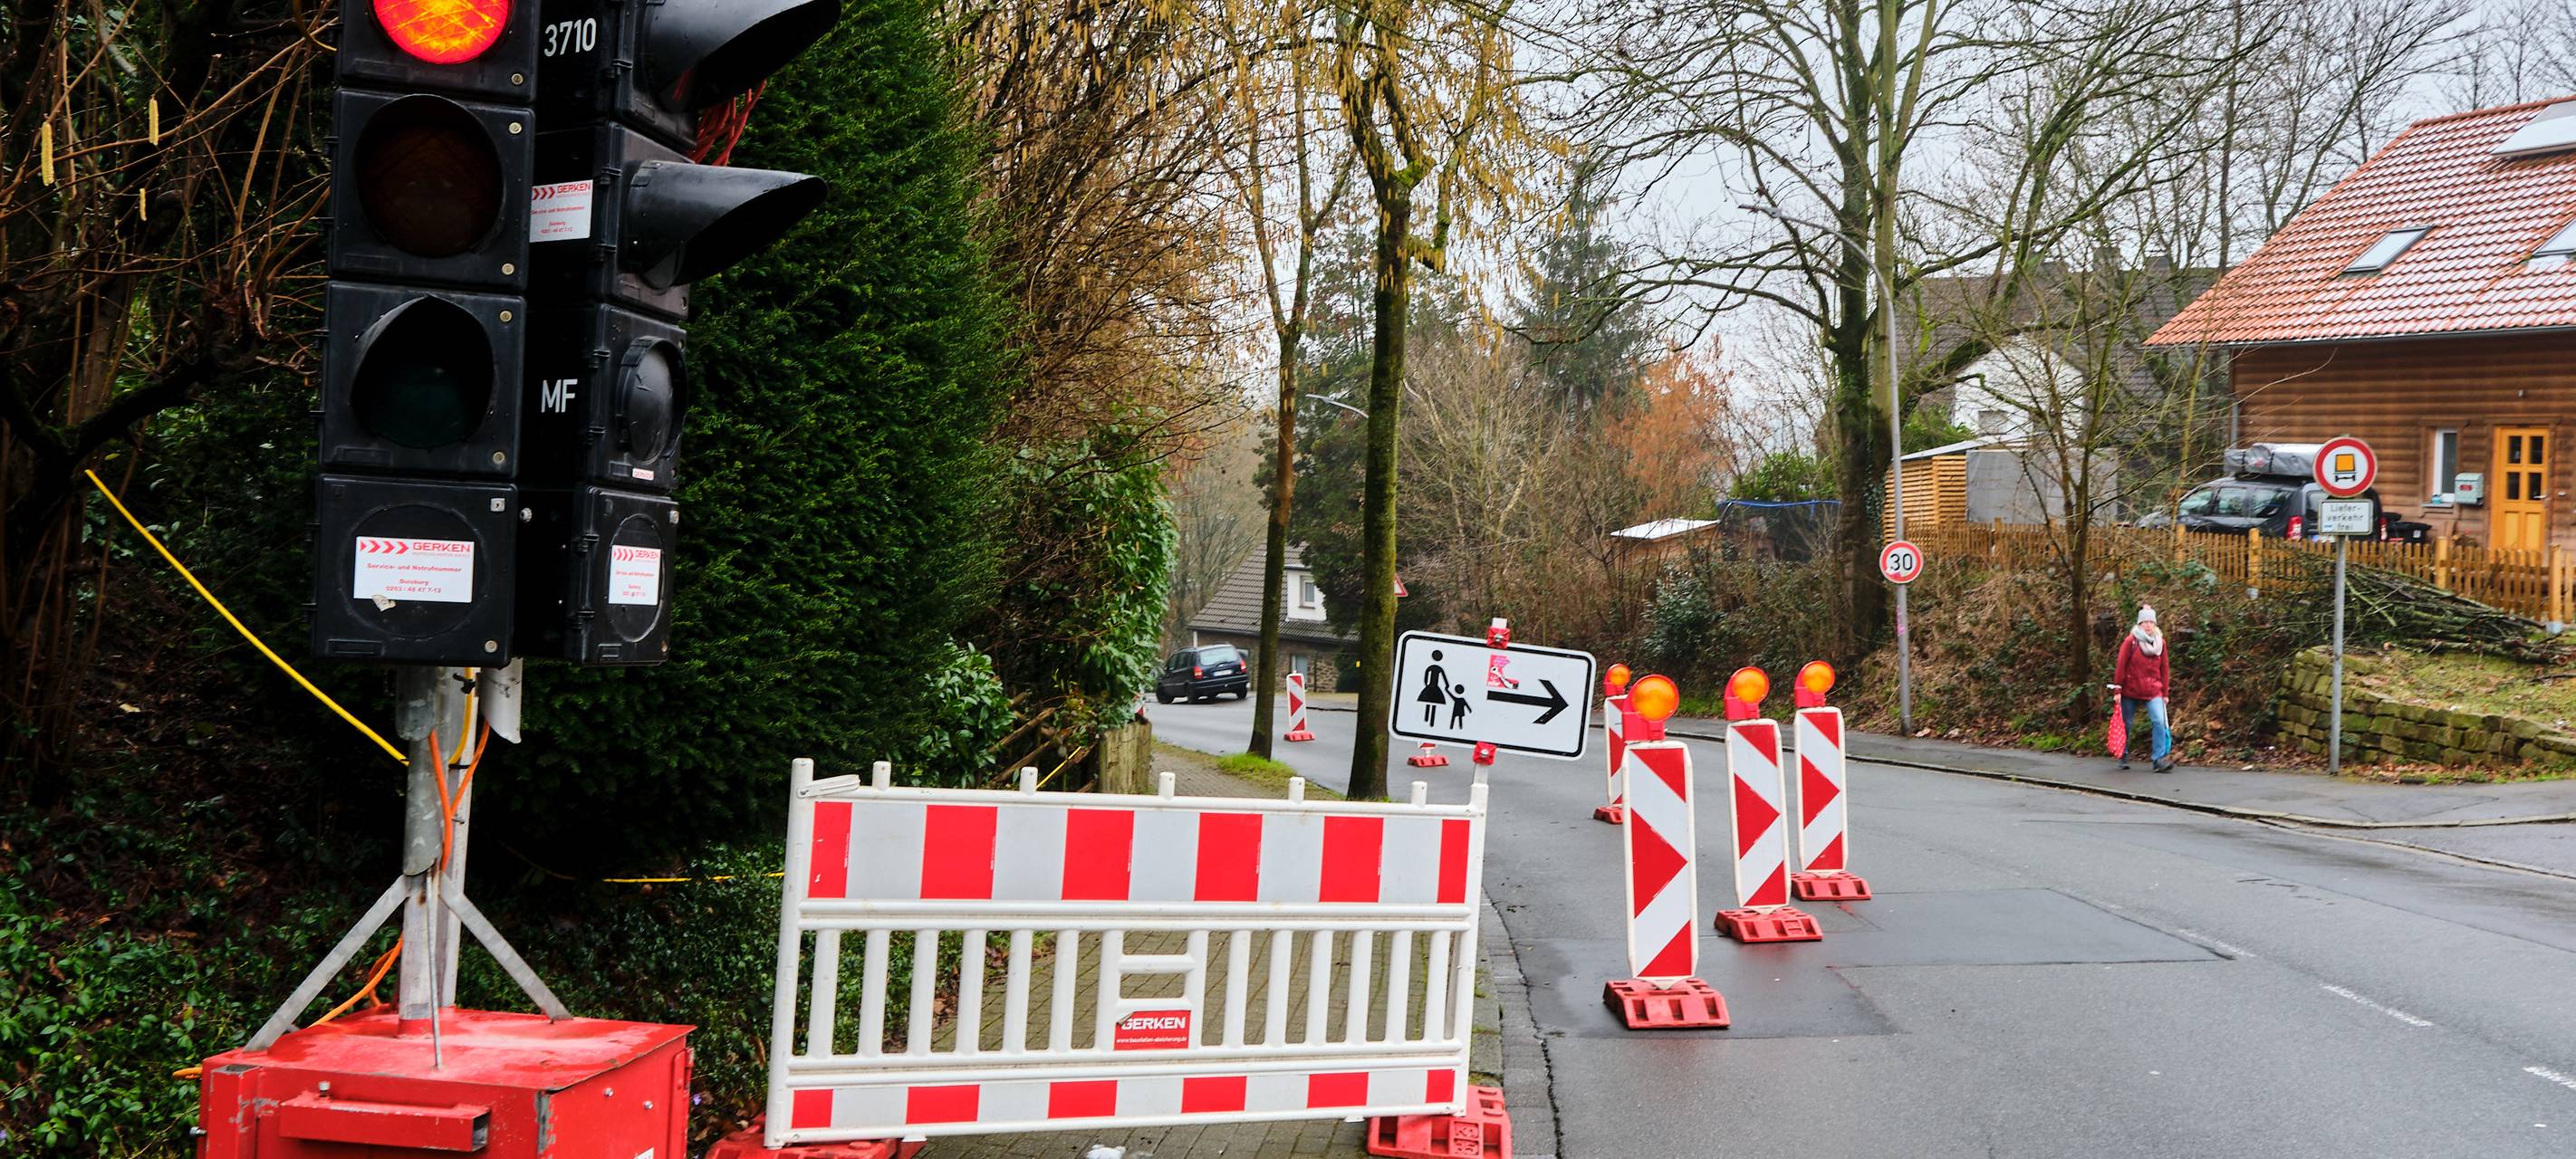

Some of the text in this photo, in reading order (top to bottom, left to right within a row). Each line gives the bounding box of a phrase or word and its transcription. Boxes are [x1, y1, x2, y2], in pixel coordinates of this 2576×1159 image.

[543, 17, 597, 57] 3710
[557, 183, 591, 194] GERKEN
[541, 378, 578, 413] MF
[2330, 504, 2361, 512] Liefer-
[2337, 522, 2353, 531] frei
[412, 542, 471, 552] GERKEN
[1890, 553, 1913, 570] 30
[1121, 1017, 1186, 1030] GERKEN
